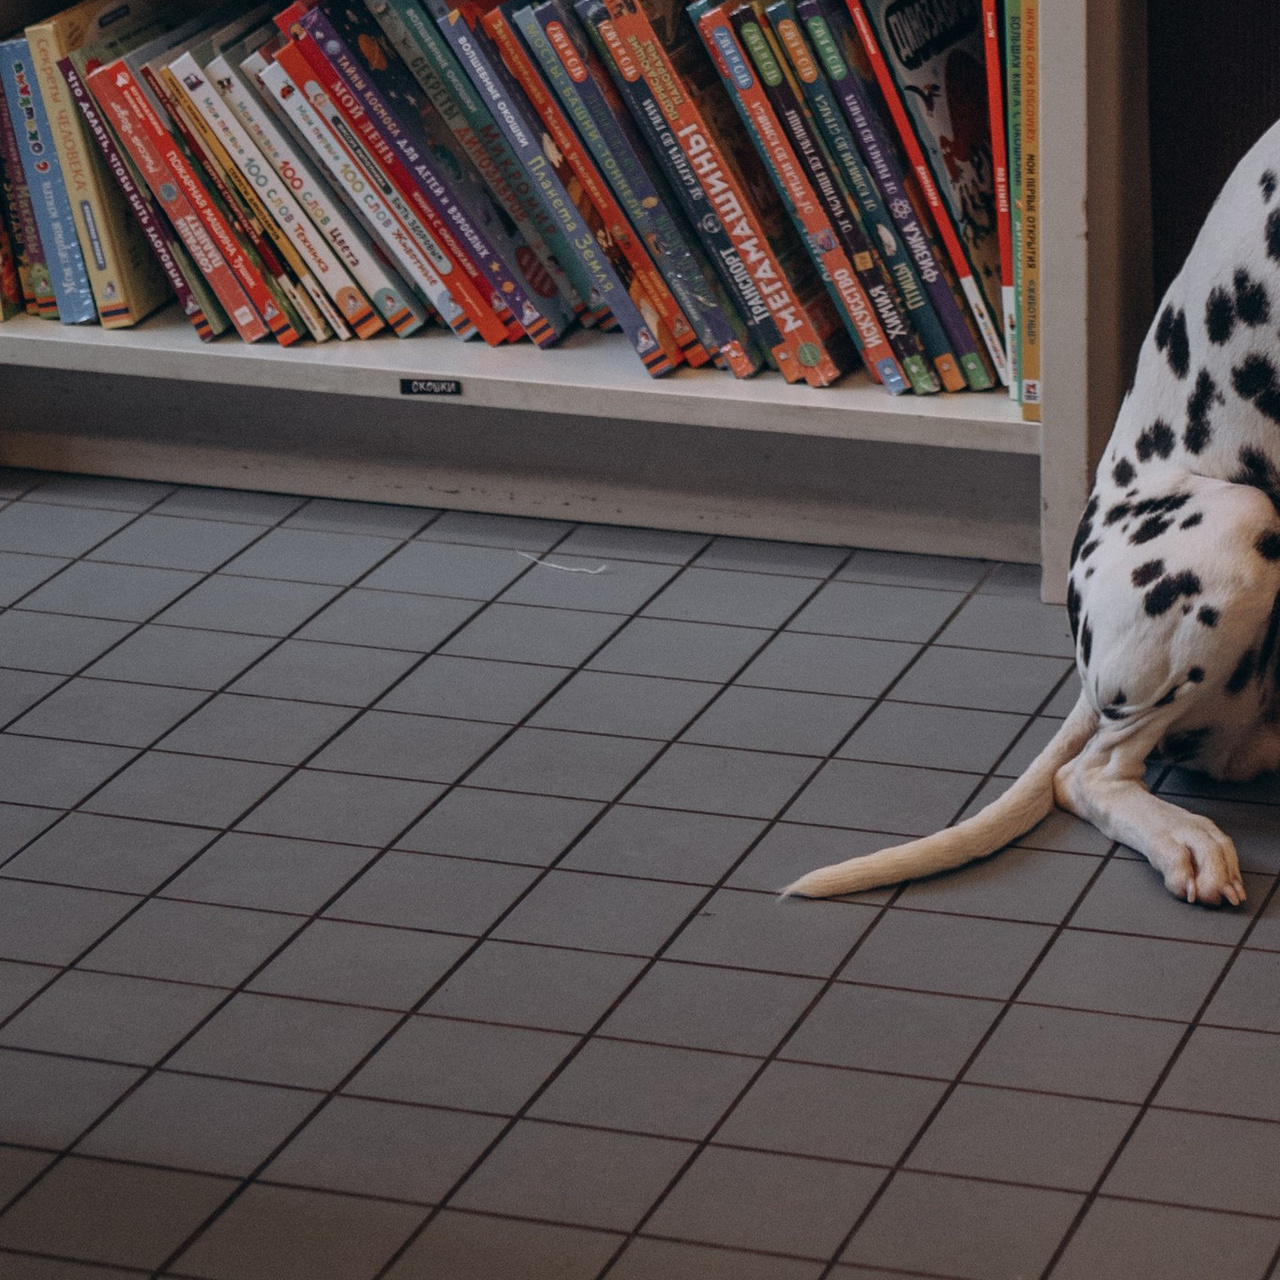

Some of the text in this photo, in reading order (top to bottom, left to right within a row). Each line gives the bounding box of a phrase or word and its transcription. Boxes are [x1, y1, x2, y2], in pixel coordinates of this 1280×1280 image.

[333, 81, 361, 120] МОЙ
[360, 121, 395, 165] ДЕНЬ
[338, 55, 365, 92] ТАЙНЫ
[364, 92, 400, 139] КОСМОСА
[397, 139, 419, 162] ДЛЯ
[415, 164, 446, 197] ДЕТЕЙ
[447, 202, 490, 259] ВЗРОСЛЫХ
[458, 36, 614, 293] ВОЛШЕБНЫЕ ОКОШКИ Планета Земля
[67, 71, 83, 100] ЧТО
[110, 153, 134, 193] ЧТОБЫ
[130, 196, 152, 230] БЫТЬ
[143, 227, 184, 289] ЗДОРОВЫМ
[166, 150, 207, 210] ПОЖАРНАЯ
[202, 208, 236, 258] МАШИНА
[233, 253, 257, 288] Тушик
[244, 156, 329, 273] 100 Техника
[280, 159, 360, 268] 100 Цвета
[341, 162, 365, 193] 100
[1027, 176, 1036, 208] ПЕРВЫЕ
[678, 123, 803, 334] МЕГАМАШИНЫ
[902, 221, 939, 284] ФИЗИКА
[1026, 211, 1036, 269] ОТКРЫТИЯ
[719, 247, 772, 325] ТРАНСПОРТ
[833, 268, 881, 350] ИСКУССТВО
[868, 285, 907, 341] ХИМИЯ
